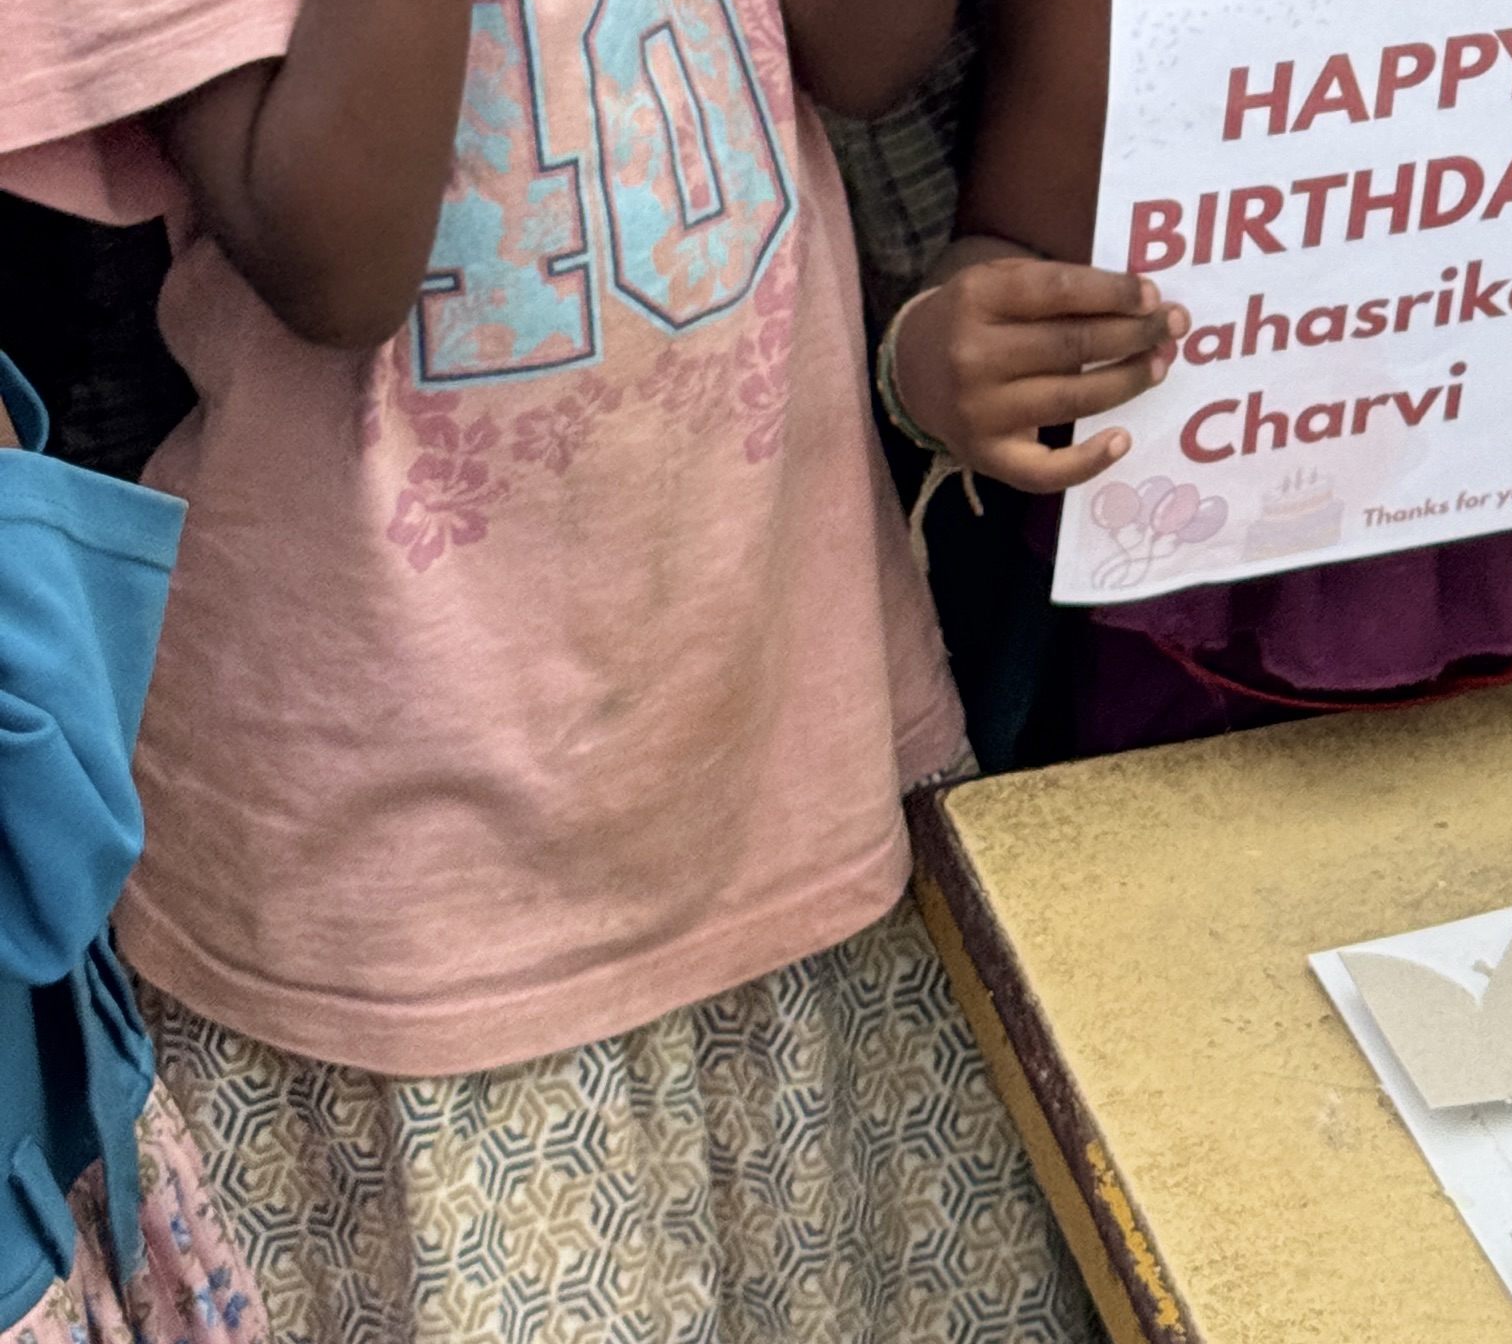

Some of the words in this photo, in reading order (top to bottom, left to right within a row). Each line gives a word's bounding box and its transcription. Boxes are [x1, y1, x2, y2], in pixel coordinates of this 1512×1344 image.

[1179, 361, 1467, 464] Charvi
[1363, 499, 1449, 528] Thanks
[1456, 490, 1491, 512] for
